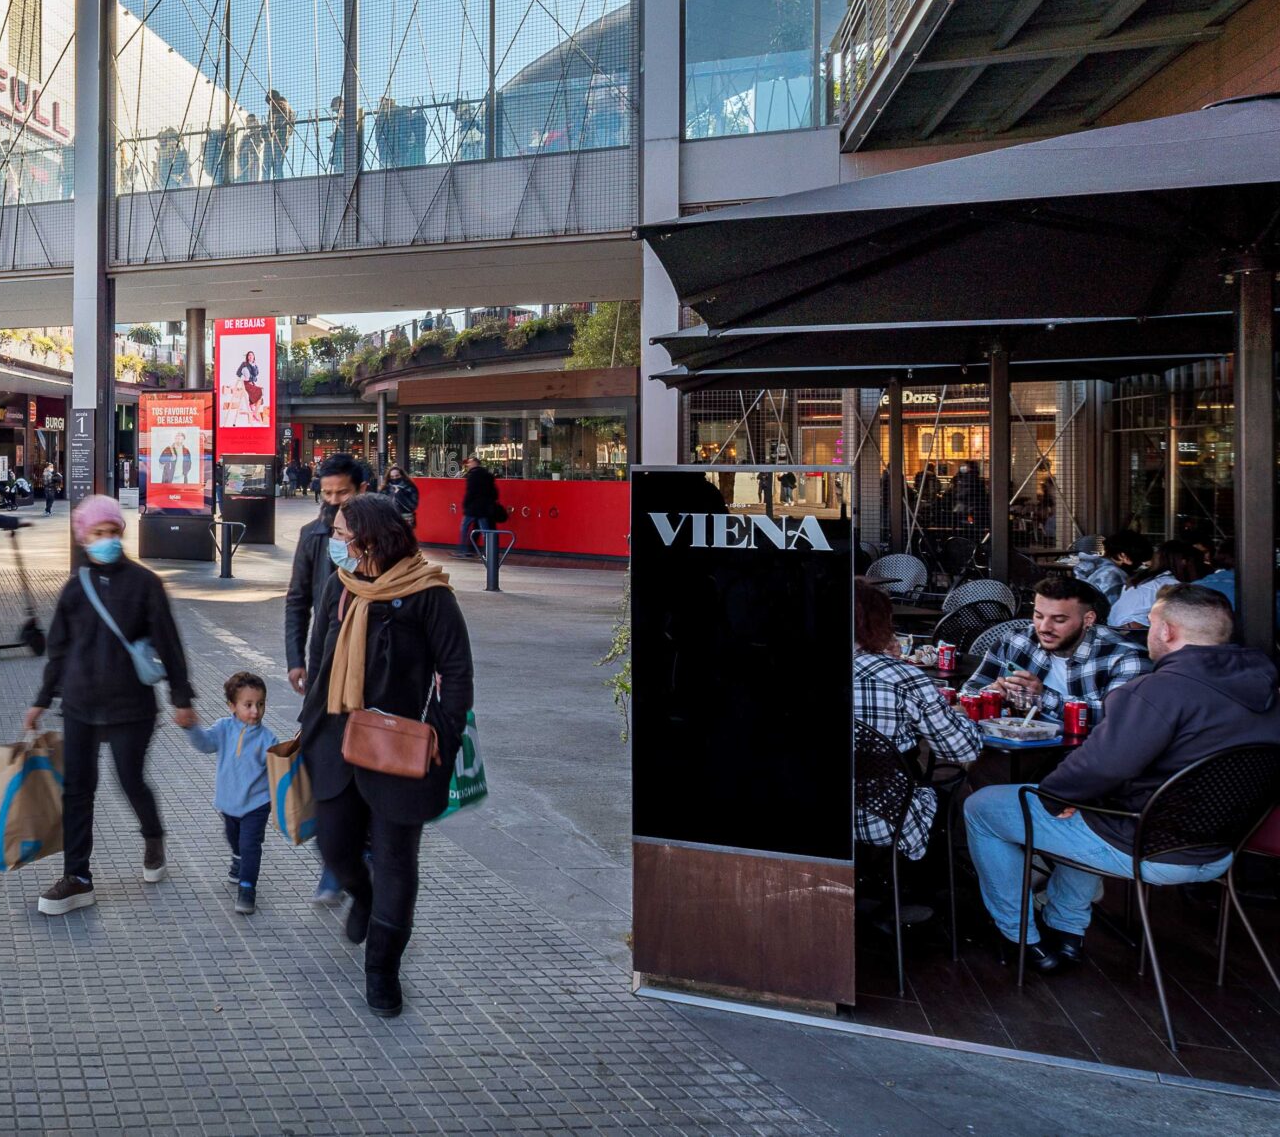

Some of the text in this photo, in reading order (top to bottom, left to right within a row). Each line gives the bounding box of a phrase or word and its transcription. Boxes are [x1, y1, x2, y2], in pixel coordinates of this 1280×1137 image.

[224, 318, 266, 329] DE REBAJAS
[76, 417, 84, 433] 1
[648, 512, 833, 551] VIENA
